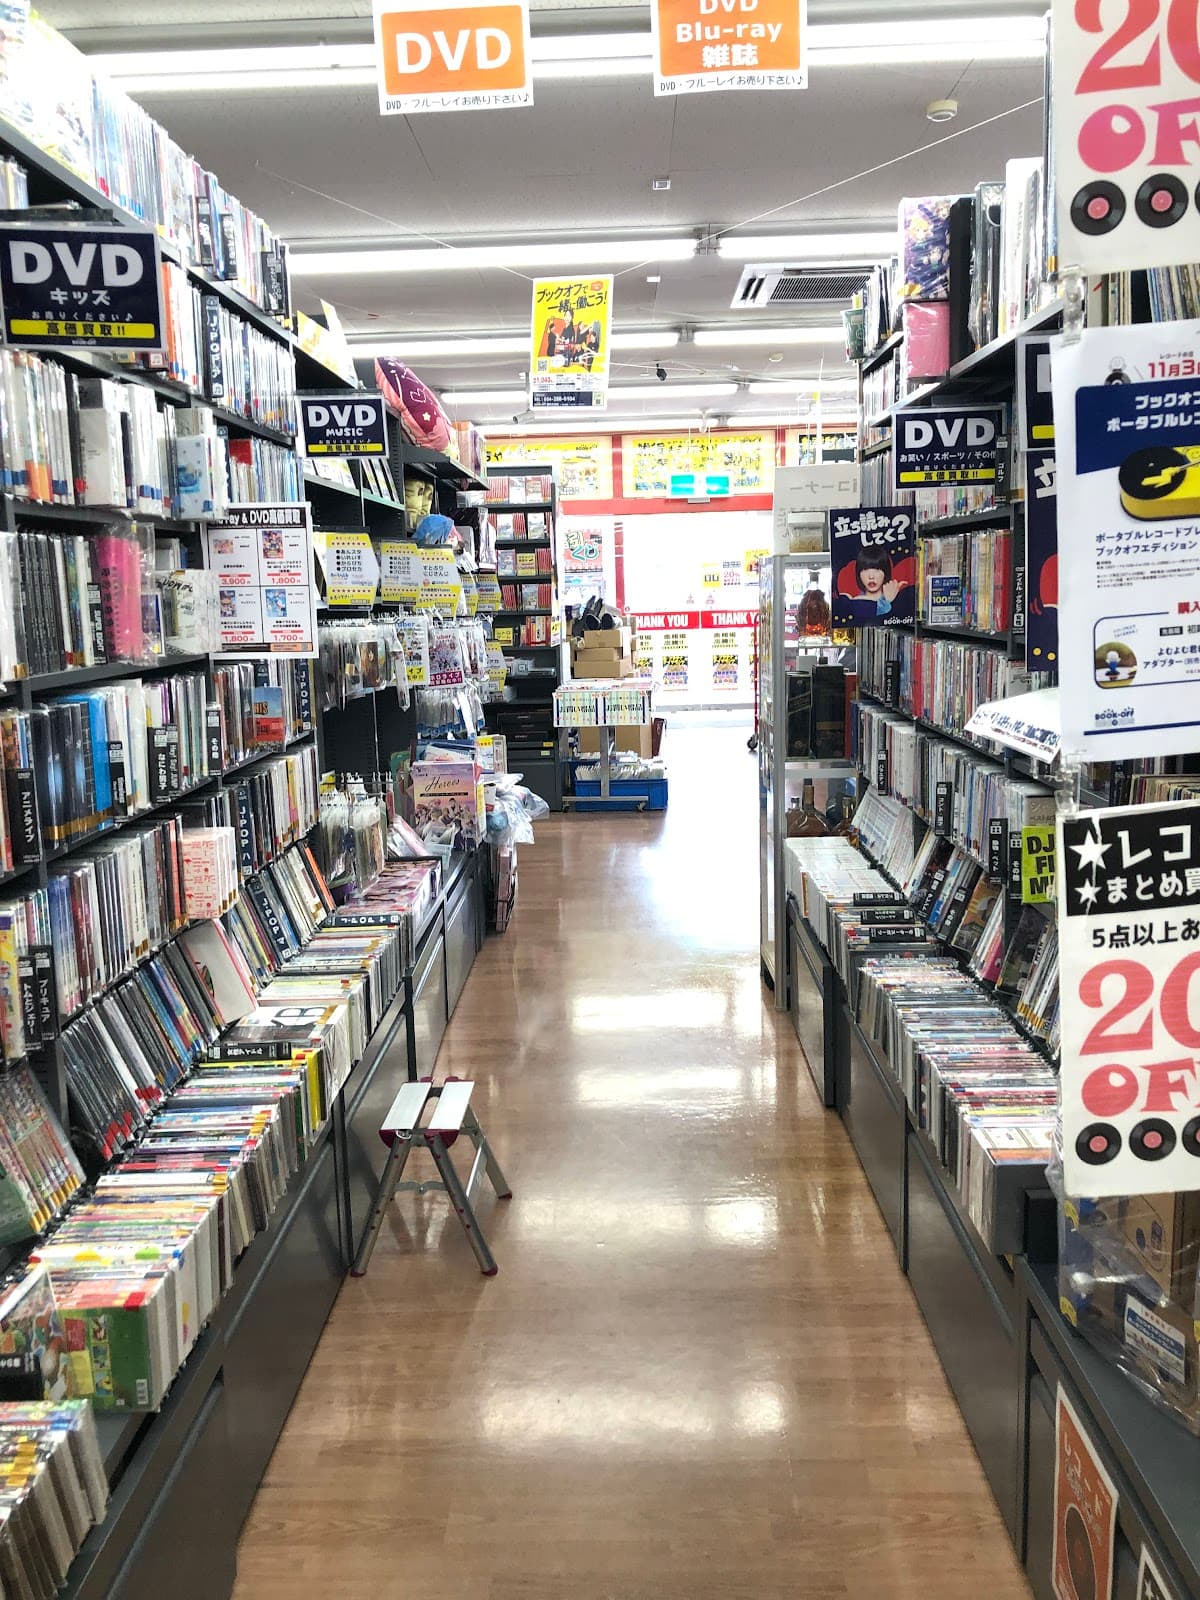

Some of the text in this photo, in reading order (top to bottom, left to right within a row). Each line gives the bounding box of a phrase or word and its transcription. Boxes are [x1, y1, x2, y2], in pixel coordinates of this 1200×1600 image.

[676, 20, 783, 44] Blu-ray
[395, 26, 513, 75] DVD
[702, 44, 759, 68] 雑誌
[9, 240, 144, 287] DVD
[50, 288, 111, 306] キッズ
[537, 283, 588, 304] ブックオフで
[1148, 359, 1200, 378] 11月3
[307, 405, 377, 428] DVD
[325, 427, 364, 438] MUSIC
[904, 418, 995, 449] DVD
[900, 453, 924, 462] お笑い
[933, 452, 965, 461] スポーツ
[834, 511, 891, 538] 立ち読み
[1096, 541, 1198, 556] ブックオフエディション
[932, 596, 948, 604] 100
[668, 614, 689, 627] YOU
[711, 612, 748, 626] THANK
[884, 616, 914, 625] BOOK-OFF
[1095, 706, 1135, 721] BOOK-OFF
[1027, 833, 1055, 855] DJ
[22, 983, 35, 1035] トムとジェリー
[38, 978, 50, 1023] プリキュア
